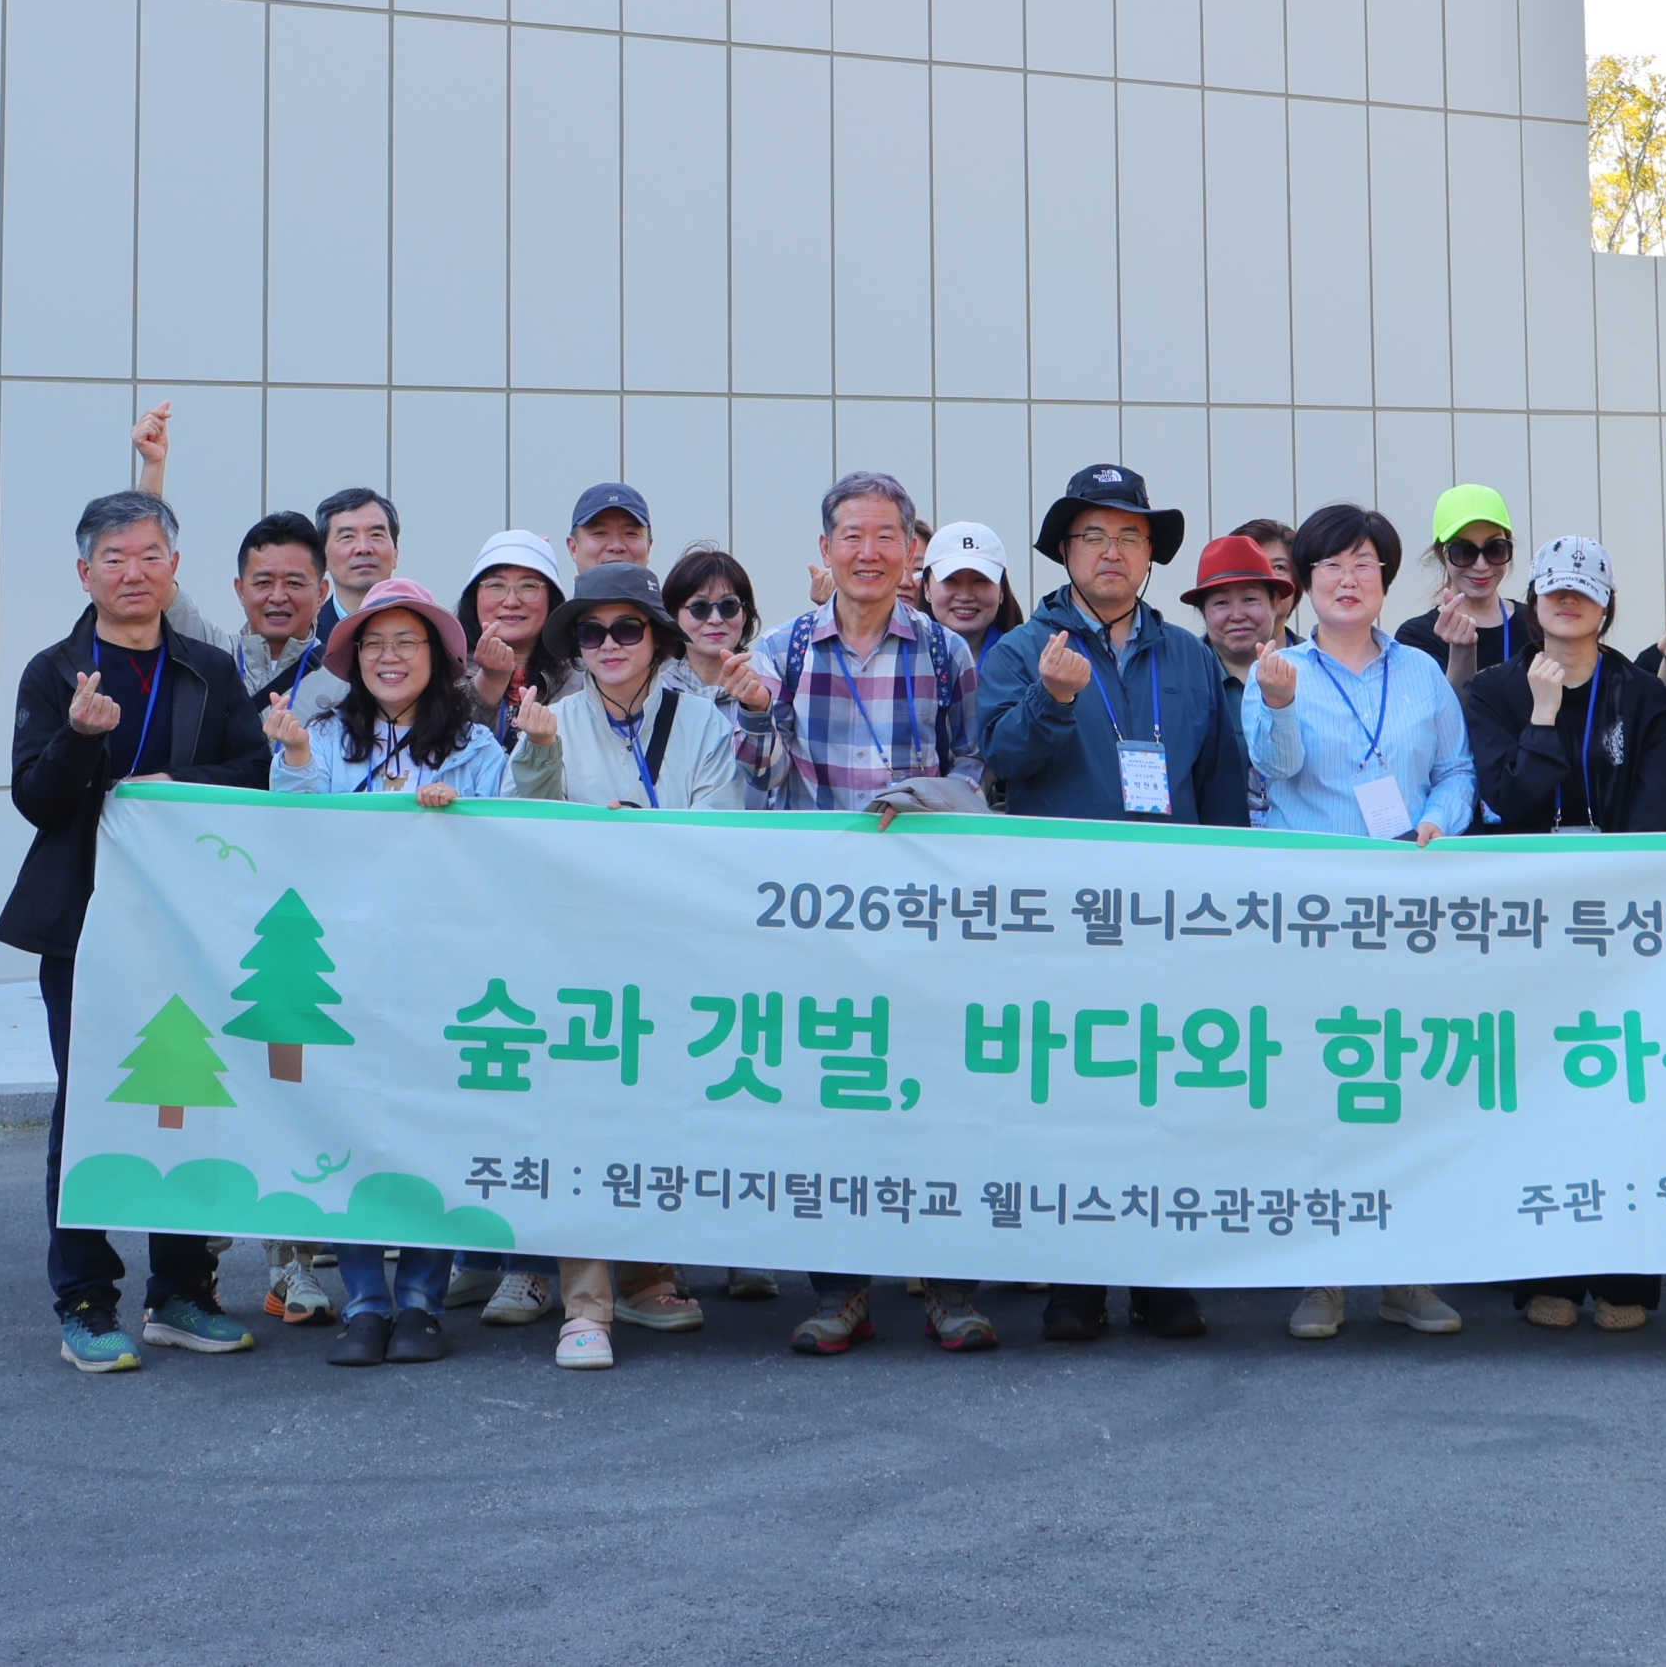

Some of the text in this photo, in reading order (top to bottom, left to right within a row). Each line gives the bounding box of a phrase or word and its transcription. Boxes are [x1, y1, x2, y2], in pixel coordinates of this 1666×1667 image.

[962, 537, 979, 549] B.
[756, 881, 1055, 942] 2026학년도
[1071, 888, 1550, 955] 웰니스치유관광학과
[443, 977, 655, 1092] 숲과
[687, 991, 921, 1111] 갯벌,
[964, 1000, 1283, 1110] 바다와
[1314, 1005, 1518, 1124] 함께
[464, 1156, 551, 1200] 주최
[601, 1163, 962, 1220] 원광디지털대학교
[979, 1180, 1393, 1237] 웰니스치유관광학과
[1517, 1178, 1607, 1226] 주관
